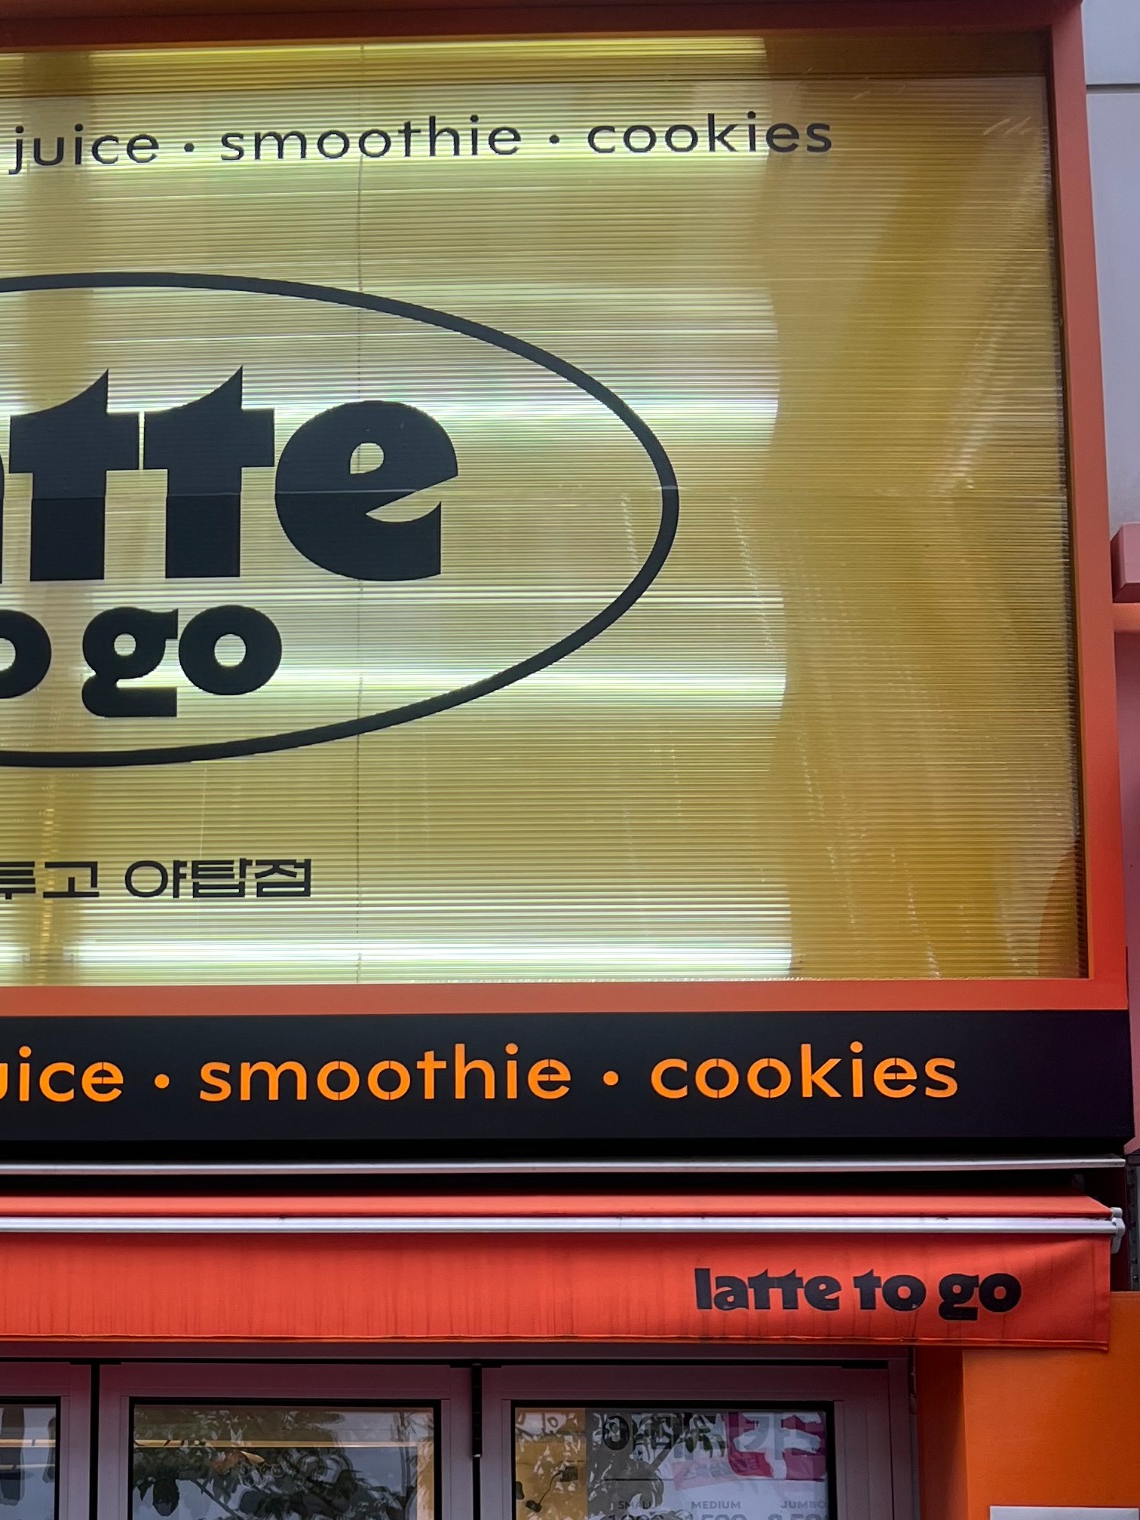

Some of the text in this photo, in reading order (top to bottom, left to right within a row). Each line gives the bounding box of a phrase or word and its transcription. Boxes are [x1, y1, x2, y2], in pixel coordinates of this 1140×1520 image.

[8, 125, 160, 175] juice
[220, 116, 522, 163] smoothie
[587, 111, 833, 155] cookies
[81, 604, 282, 718] go
[124, 858, 312, 898] 야탑점
[198, 1044, 573, 1101] smoothie
[651, 1041, 958, 1100] cookies
[694, 1267, 1022, 1321] latte to go
[691, 1500, 741, 1510] MEDIUM
